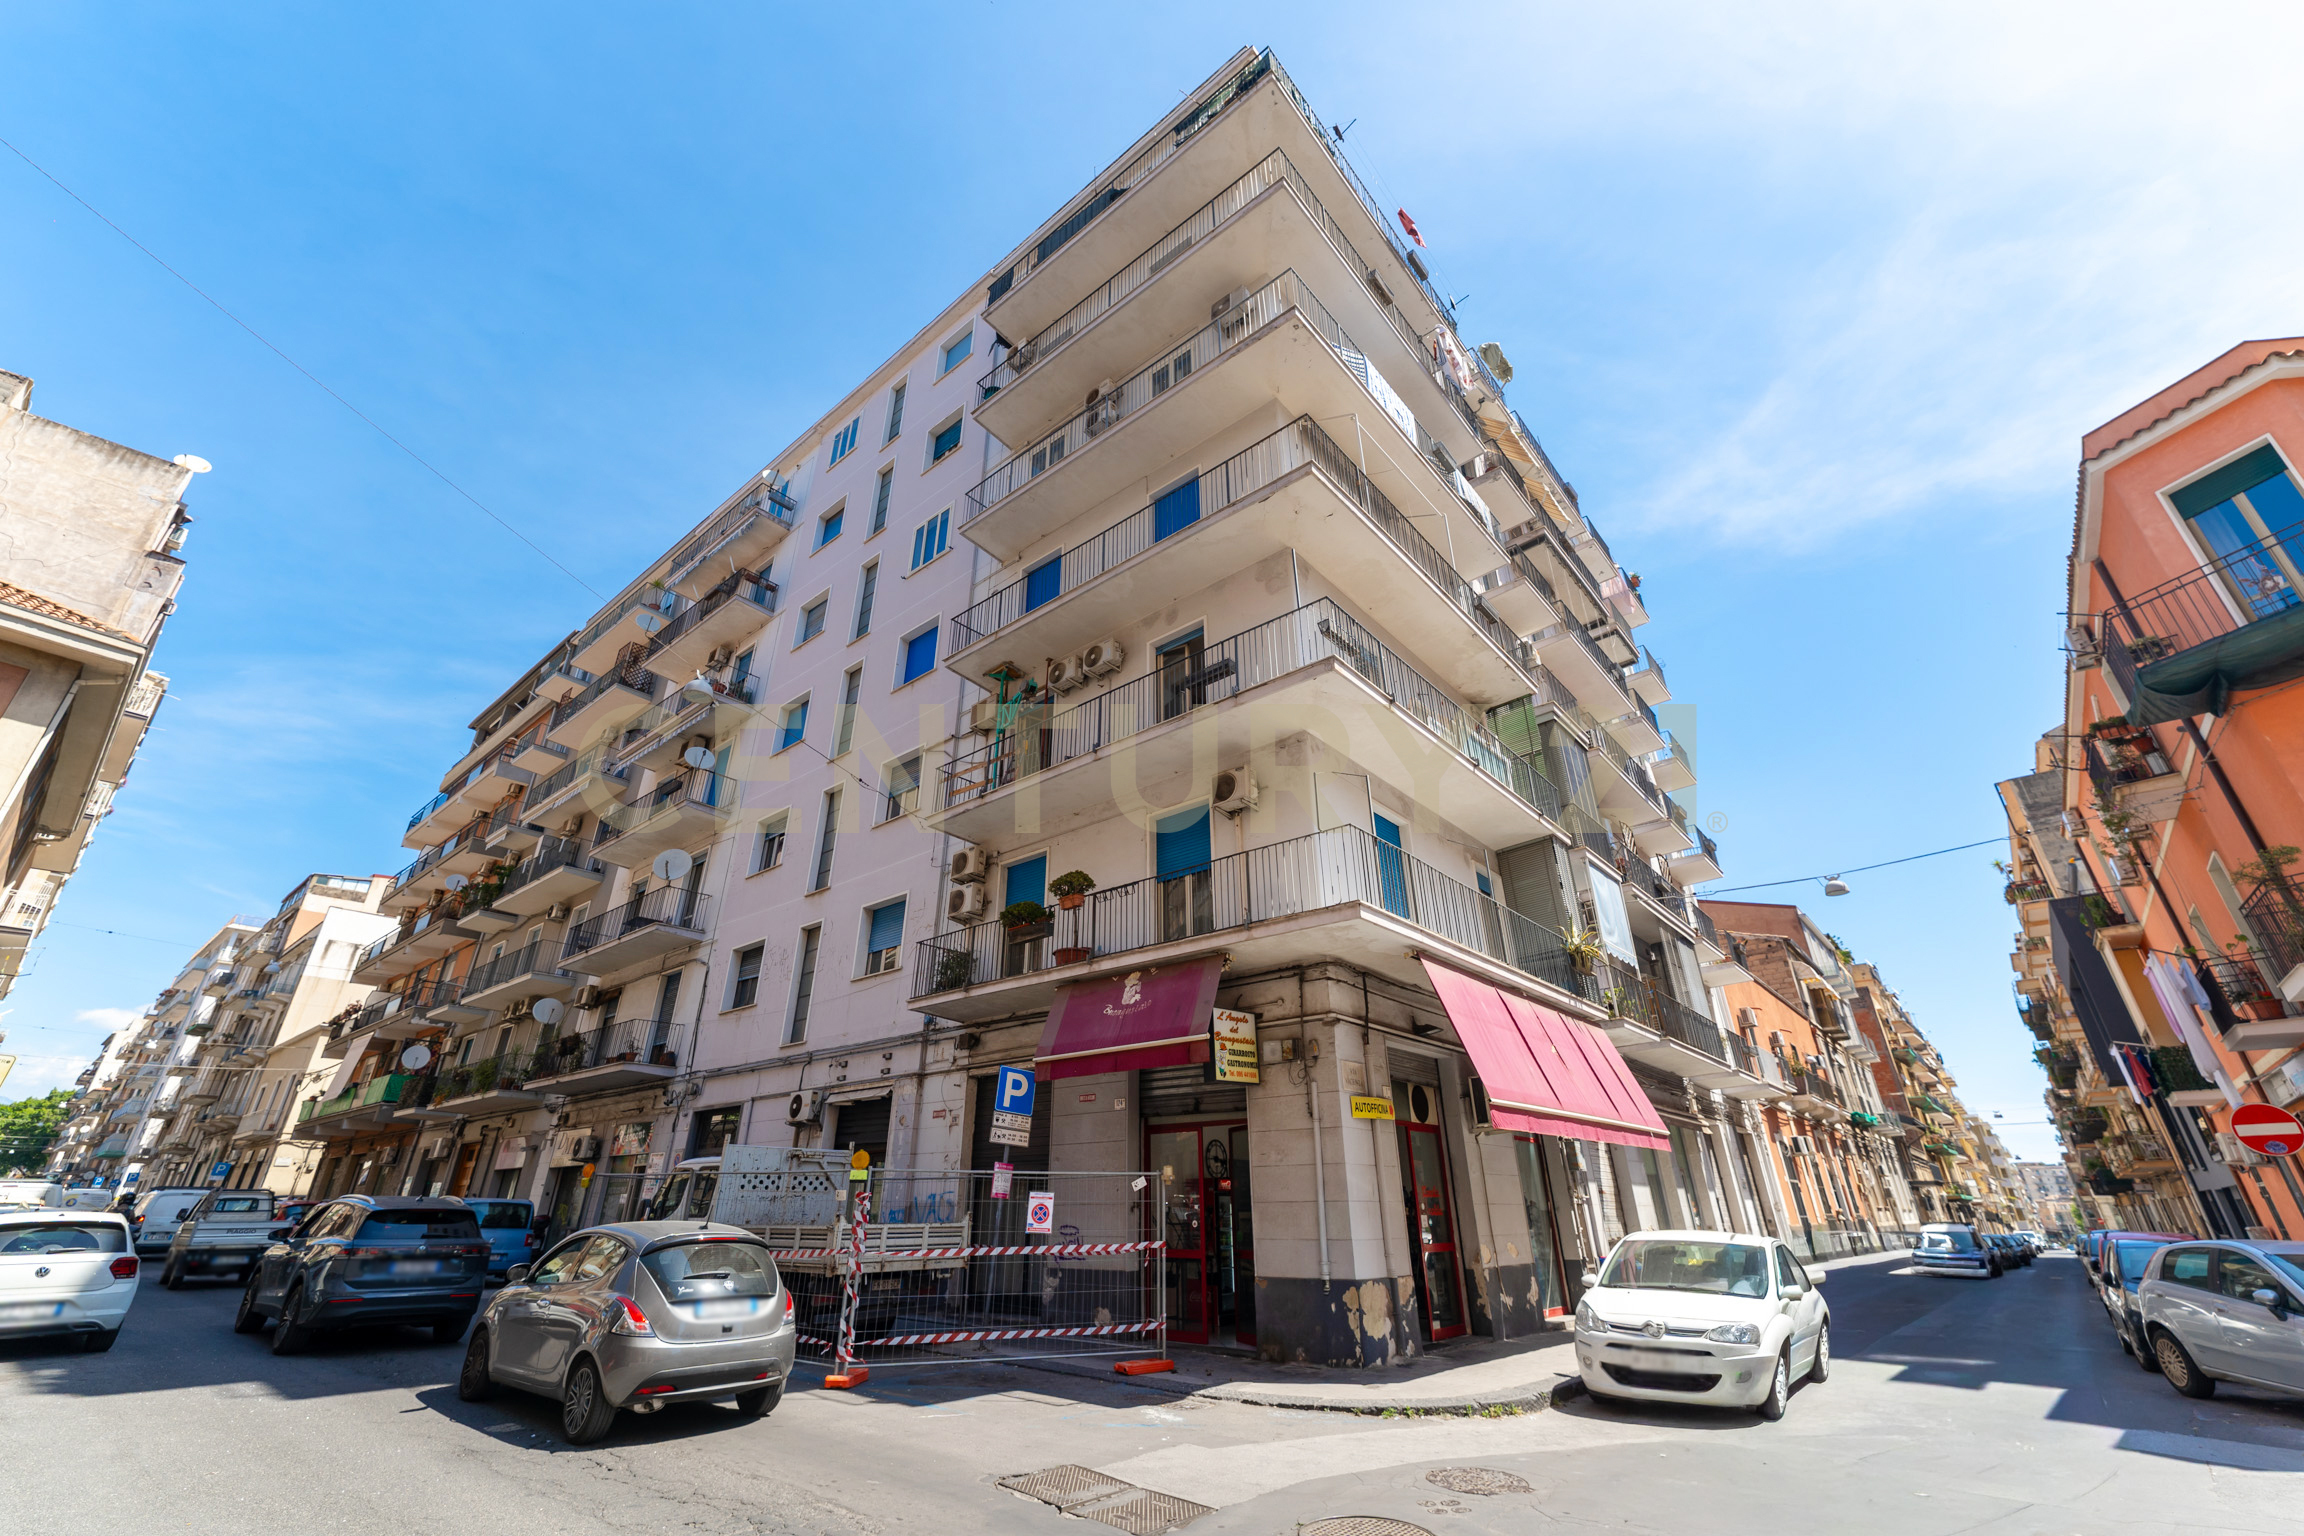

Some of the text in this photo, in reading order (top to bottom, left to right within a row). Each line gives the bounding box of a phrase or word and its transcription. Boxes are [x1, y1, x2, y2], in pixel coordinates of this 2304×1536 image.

[1216, 1010, 1249, 1025] L'Angolo
[1229, 1026, 1239, 1034] del
[1214, 1031, 1256, 1046] Buongustaio
[1003, 1071, 1029, 1108] P
[1354, 1101, 1389, 1115] AUTOFFICINA
[215, 1164, 227, 1174] P
[127, 1173, 137, 1182] P
